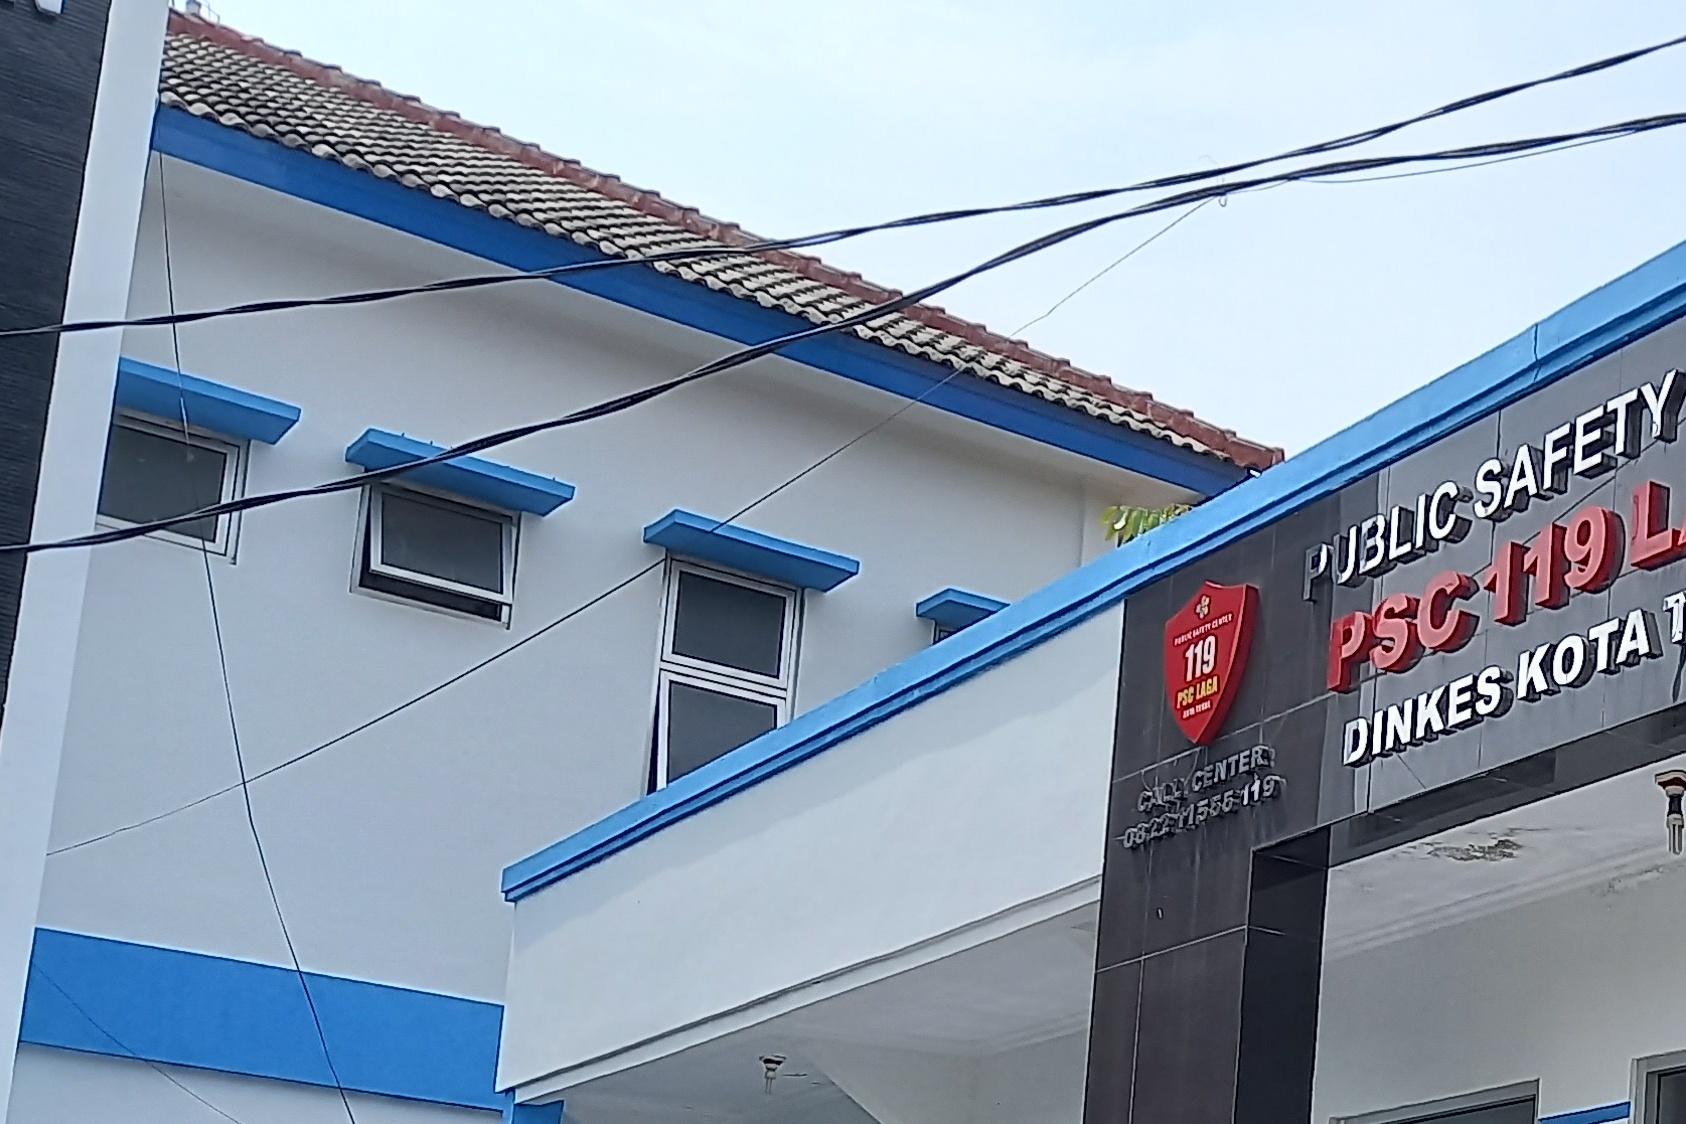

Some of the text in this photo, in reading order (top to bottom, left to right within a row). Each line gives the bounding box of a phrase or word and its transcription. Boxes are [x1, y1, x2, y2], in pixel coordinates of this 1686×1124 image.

[1303, 480, 1463, 601] PUBLIC
[1473, 369, 1682, 519] SAFETY
[1327, 570, 1471, 692] PSC
[1484, 505, 1614, 625] 119
[1177, 675, 1218, 709] PSC LAGA
[1185, 635, 1216, 682] 119
[1342, 665, 1506, 766] DINKES
[1517, 608, 1655, 700] KOTA
[1192, 745, 1271, 792] CENTER
